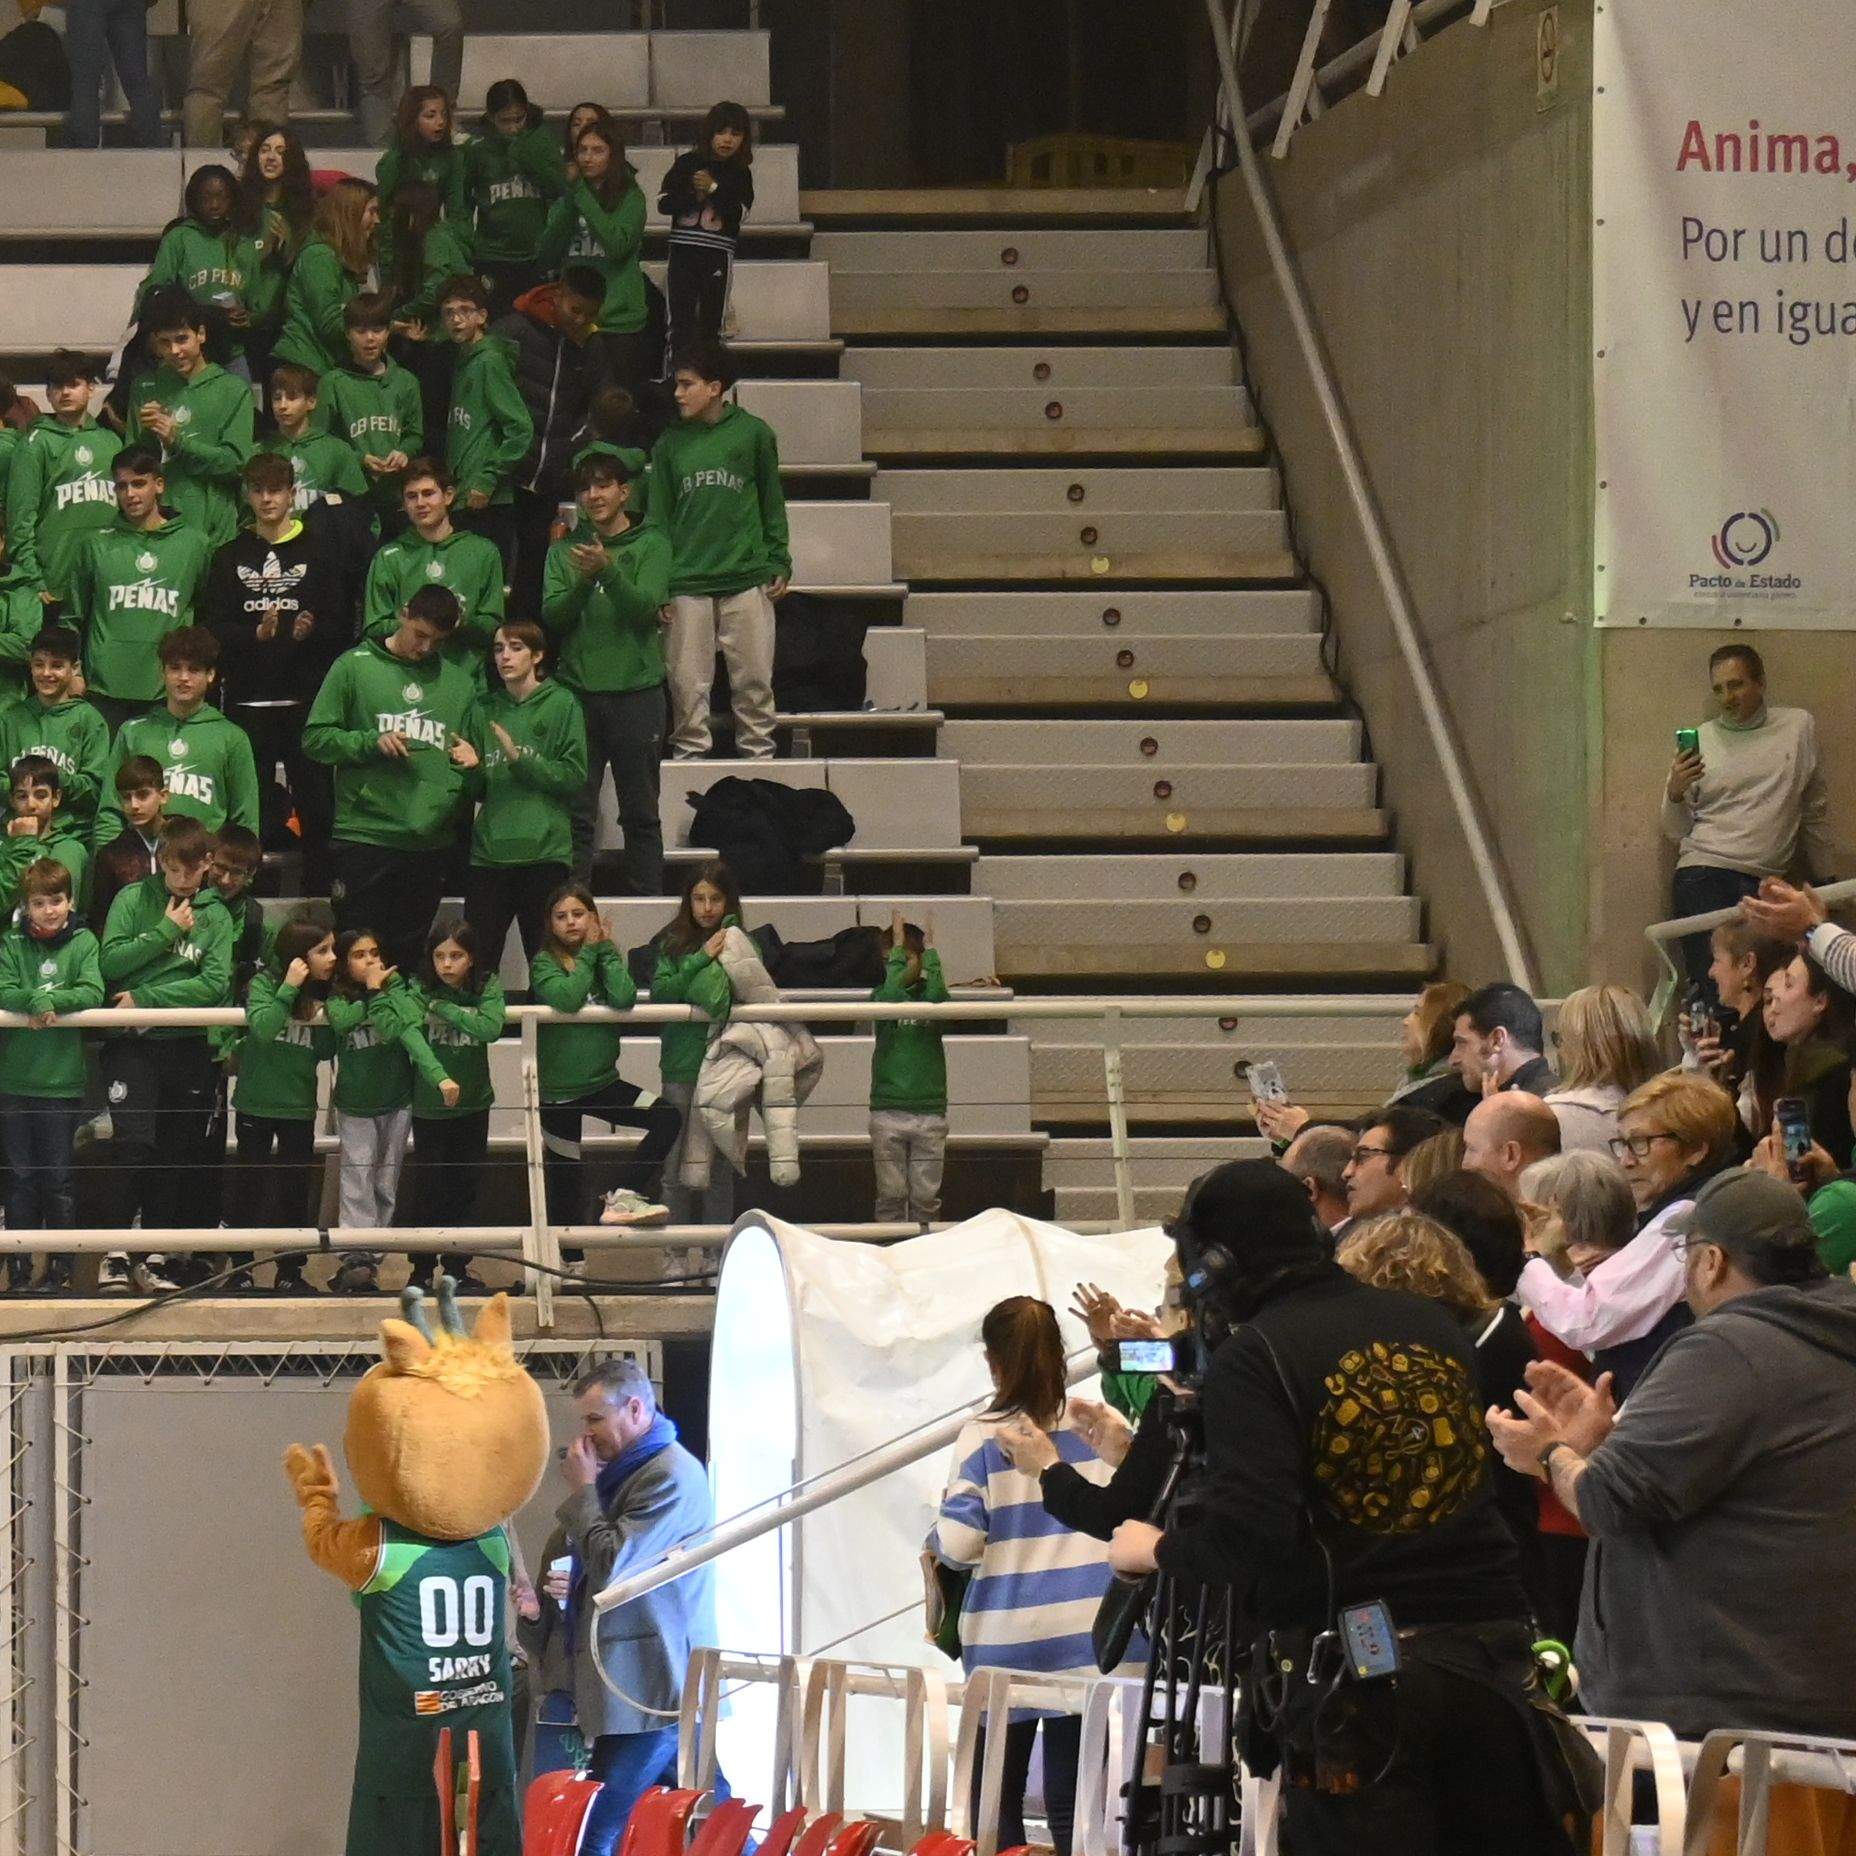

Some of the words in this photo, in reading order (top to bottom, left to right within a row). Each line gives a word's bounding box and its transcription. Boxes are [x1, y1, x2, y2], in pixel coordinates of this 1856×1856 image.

[1675, 119, 1856, 182] Anima,
[1681, 216, 1747, 263] Por
[1760, 228, 1808, 263] un
[1681, 298, 1705, 343] y
[1713, 298, 1760, 334] en
[1689, 573, 1733, 588] Pacto
[1749, 573, 1802, 589] Estado
[243, 598, 300, 613] adidas
[419, 1574, 495, 1648] 00
